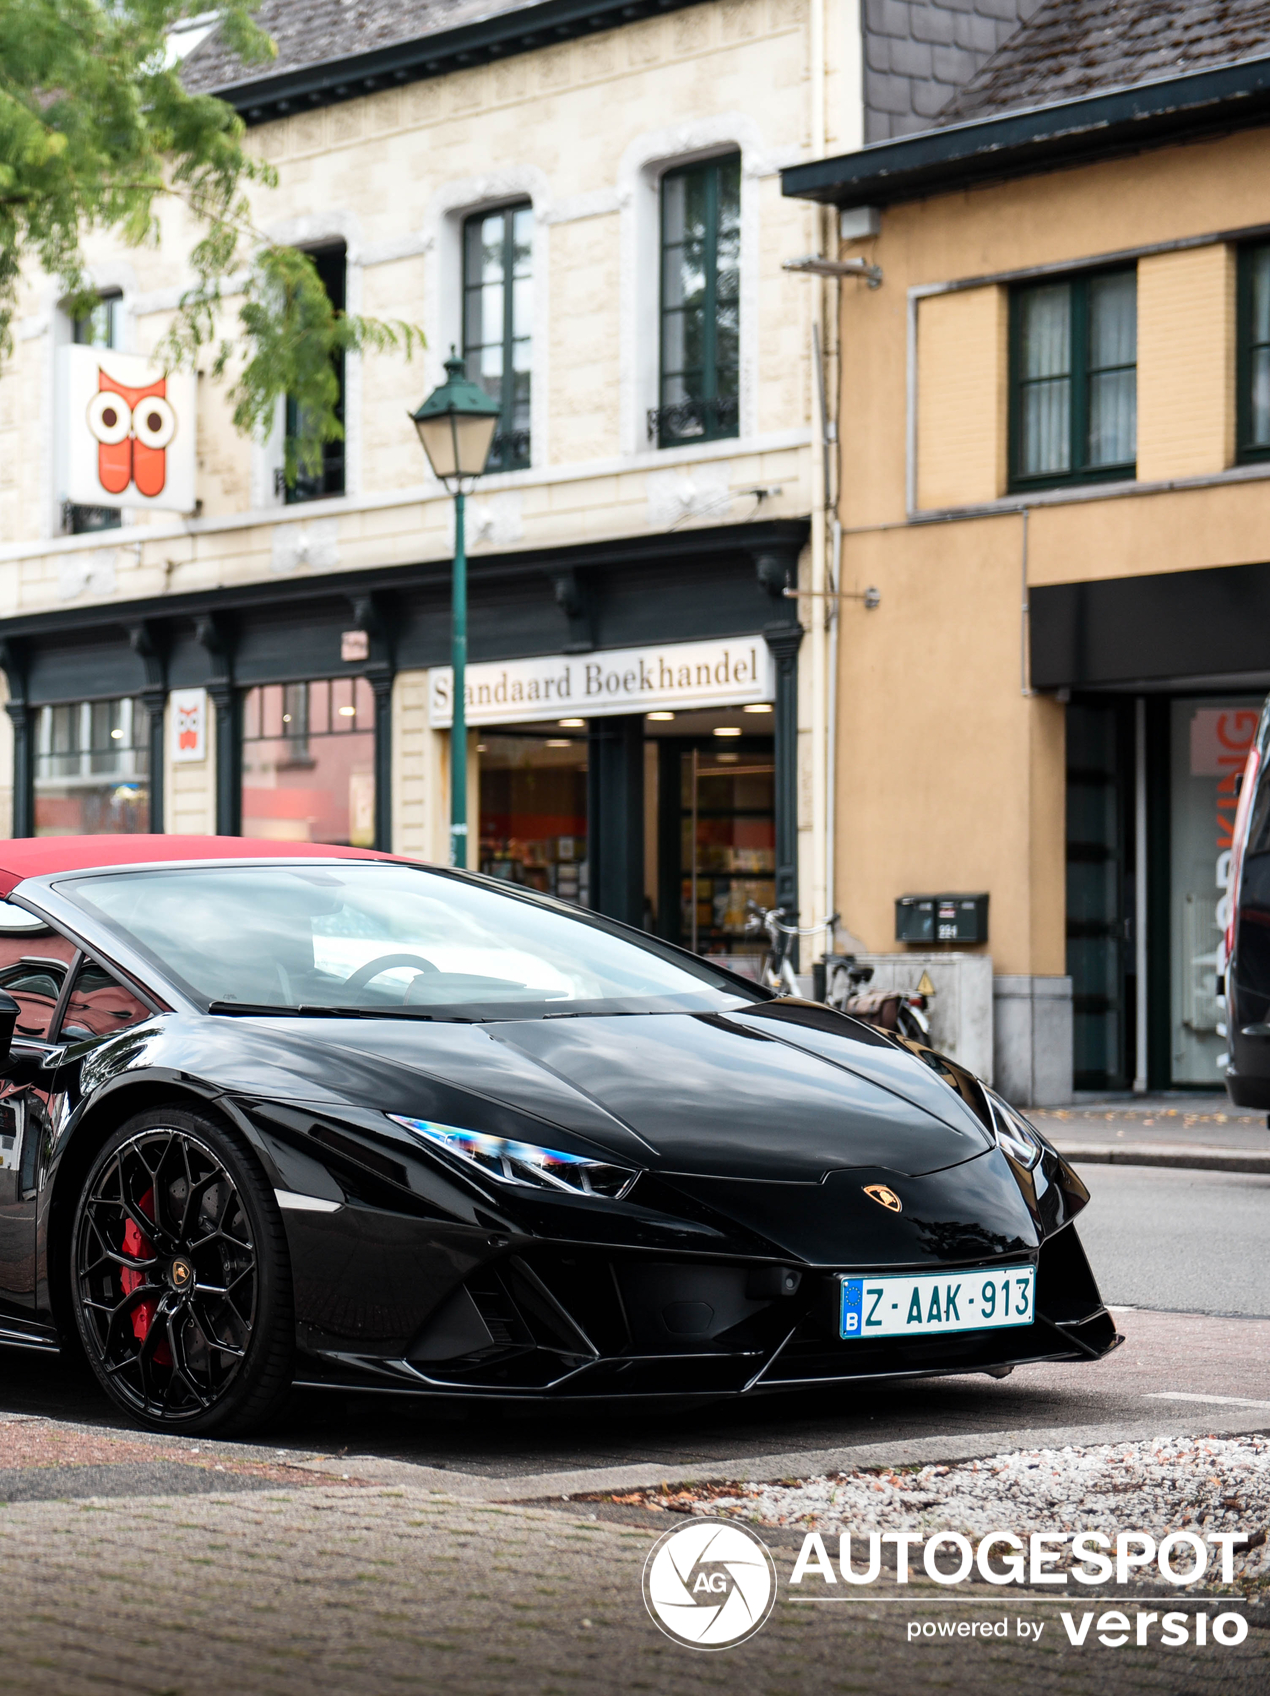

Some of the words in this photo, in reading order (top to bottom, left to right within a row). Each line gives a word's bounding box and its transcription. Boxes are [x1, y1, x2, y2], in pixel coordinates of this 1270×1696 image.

[434, 667, 571, 709] Sandaard
[585, 649, 758, 696] Boekhandel
[846, 1312, 859, 1331] B
[866, 1278, 1029, 1326] Z-AAK-913
